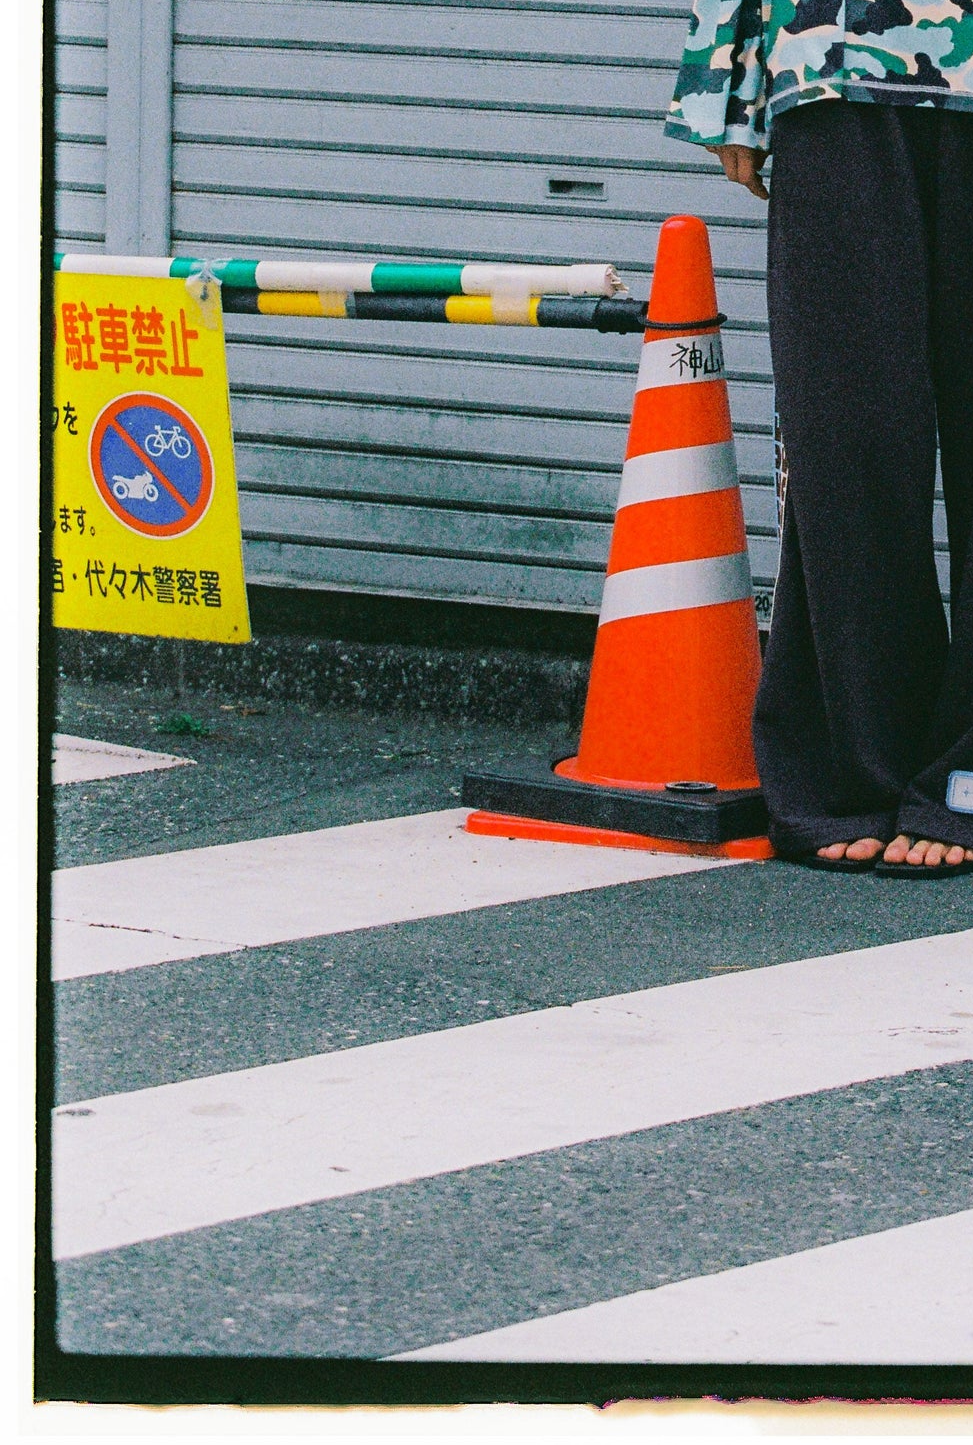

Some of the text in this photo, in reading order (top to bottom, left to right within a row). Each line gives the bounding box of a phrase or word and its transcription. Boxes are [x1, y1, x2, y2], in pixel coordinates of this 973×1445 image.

[61, 301, 204, 377] 駐車禁止
[54, 504, 96, 537] ます。
[754, 595, 772, 612] 20
